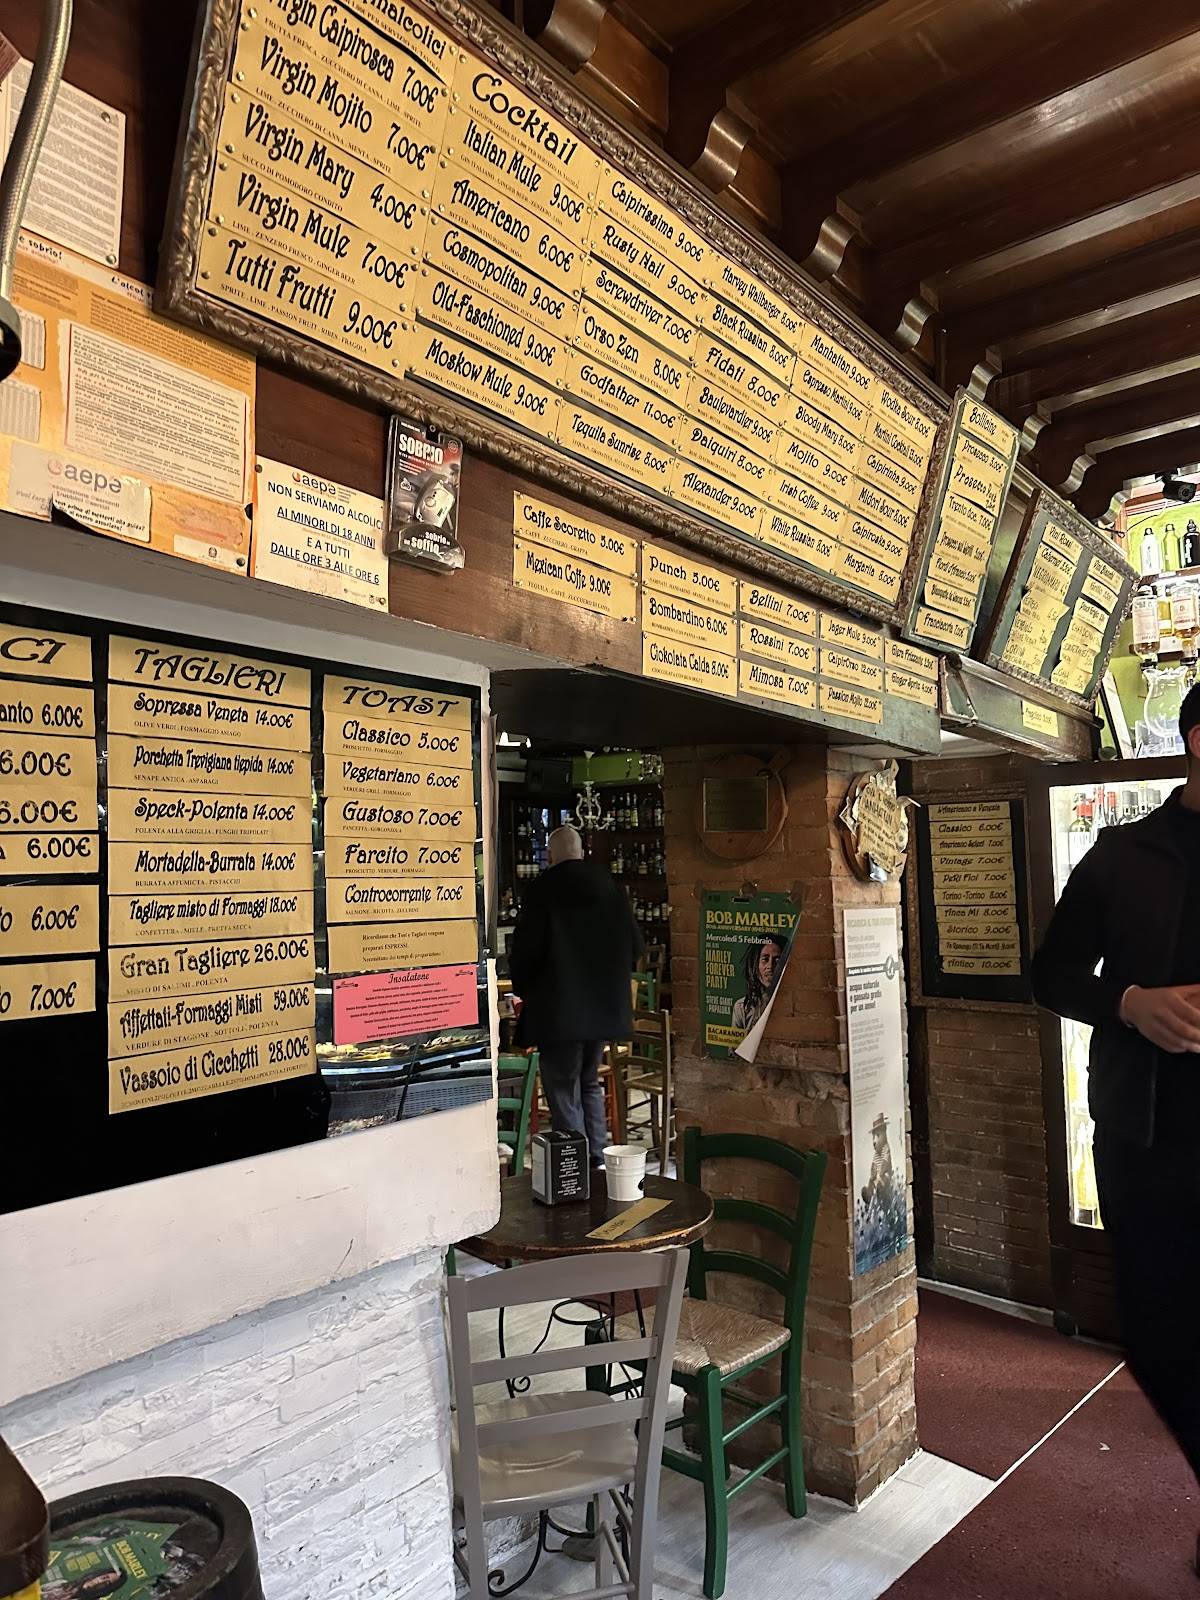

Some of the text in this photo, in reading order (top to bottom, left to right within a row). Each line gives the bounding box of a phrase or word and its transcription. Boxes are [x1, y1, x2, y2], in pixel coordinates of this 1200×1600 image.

[319, 5, 438, 113] Caipirosca 7.00€
[260, 35, 430, 171] Virgin Mojito 7.00€
[472, 73, 577, 165] Cocktail
[245, 103, 416, 229] Virgin Mary 4.00€
[463, 119, 584, 223] Italian Mule 9.00€
[237, 172, 409, 288] Virgin Mule 7.00€
[451, 179, 574, 272] Americano 6.00€
[612, 181, 703, 262] Caipirissima 9.00€
[443, 230, 565, 320] Cosmopolitan 9.00€
[603, 225, 698, 305] Rusty Nail 9.00€
[225, 239, 397, 348] Tutti Frutti 9.00€
[596, 270, 692, 344] Screwdriver 7.00€
[432, 281, 556, 367] Old-Faschioned 9.00€
[585, 316, 681, 389] Orso Zen 8.00€
[425, 338, 548, 416] Moskow Mule 9.00€
[706, 347, 780, 407] Fidati 8.00€
[581, 365, 675, 428] Godfather 11.00€
[691, 428, 764, 479] Daiquiri 8.00€
[787, 442, 847, 485] Mojito 9.00€
[267, 481, 292, 498] NON
[295, 489, 345, 516] SERVIAMO
[277, 506, 376, 549] AI MINORI DI 18 ANNI
[524, 505, 625, 555] Caffe Scoretto 5.00€
[271, 543, 380, 584] DALLE ORE 3 ALLE ORE 6
[307, 538, 350, 558] E A TUTTI
[527, 551, 611, 597] Mexican Coffe 9.00€
[650, 556, 720, 592] Punch 5.00€
[650, 598, 727, 635] Bombardino 6.00€
[750, 590, 810, 623] Bellini 7.00€
[750, 628, 810, 659] Rossini 7.00€
[135, 648, 286, 696] TAGLIERI
[750, 666, 810, 695] Mimosa 7.00€
[134, 692, 294, 729] Sopressa Veneta 14.00€
[343, 686, 459, 717] TOAST
[343, 720, 459, 752] Classico 5.00€
[134, 745, 294, 775] Porchetta Trevigiana tiepida 14.00€
[343, 762, 459, 788] Vegetariano 6.00€
[135, 797, 296, 822] Speck-Polenta 14.00€
[343, 801, 462, 826] Gustoso 7.00€
[27, 837, 91, 859] 6.00€
[135, 850, 296, 874] Mortadella-Burrata 14.00€
[345, 844, 461, 864] Farcito 7.00€
[130, 896, 297, 924] Tagliere misto di Formaggi 18.00€
[345, 884, 463, 903] Controcorrente 7.00€
[32, 905, 79, 931] 6.00€
[706, 910, 796, 928] BOB MARLEY
[120, 939, 309, 978] Gran Tagliere 26.00€
[706, 950, 731, 963] MARLEY
[743, 937, 772, 945] Febbraio
[706, 963, 734, 977] FOREVER
[706, 976, 728, 989] PARTY
[30, 982, 77, 1011] 7.00€
[120, 987, 309, 1038] Affettati-Formaggi Misti 59.00€
[120, 1062, 180, 1095] Vassoio
[185, 1055, 197, 1081] di
[202, 1045, 259, 1077] Cicchetti
[269, 1036, 309, 1063] 28.00€
[116, 1541, 147, 1579] BOB MARLEY
